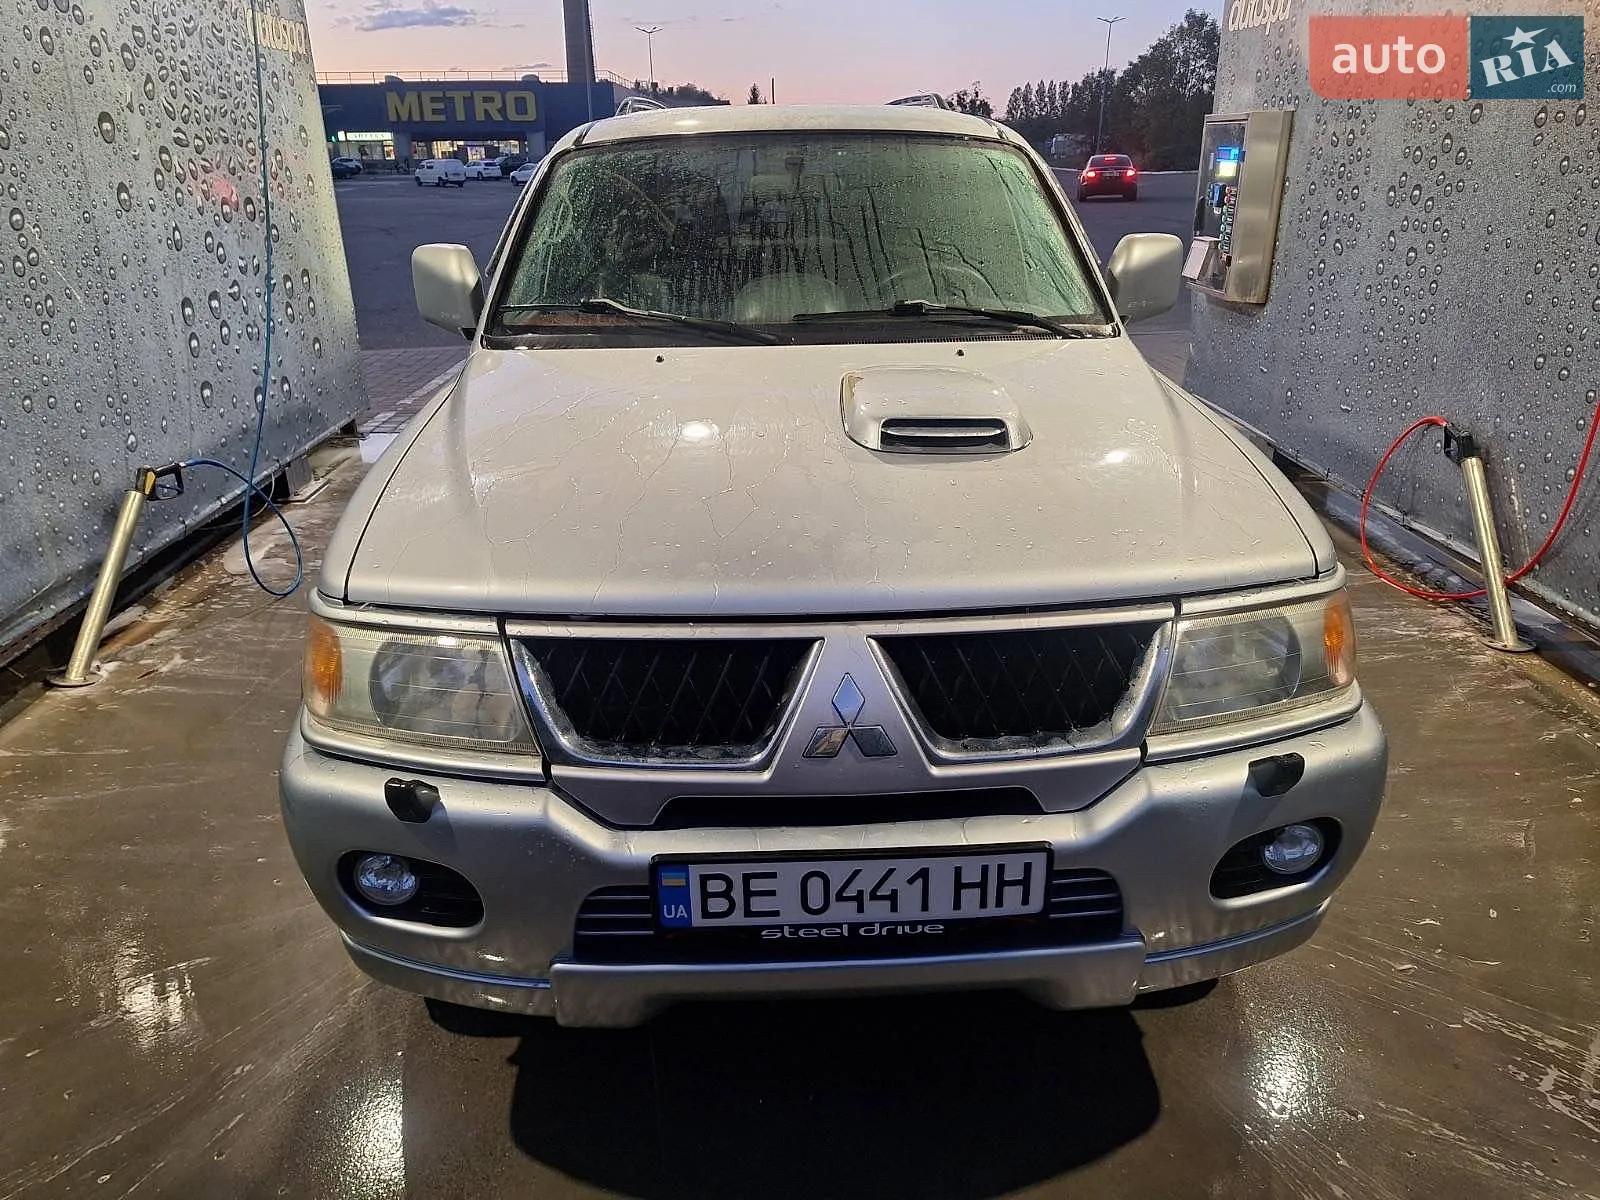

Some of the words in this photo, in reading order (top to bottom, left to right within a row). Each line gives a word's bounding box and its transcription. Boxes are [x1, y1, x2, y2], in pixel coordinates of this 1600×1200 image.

[385, 91, 537, 122] METRO
[699, 872, 781, 920] BE
[800, 867, 930, 916] 0441
[952, 862, 1033, 911] HH
[663, 904, 688, 919] UA
[760, 924, 849, 939] steel
[858, 923, 945, 936] drive
